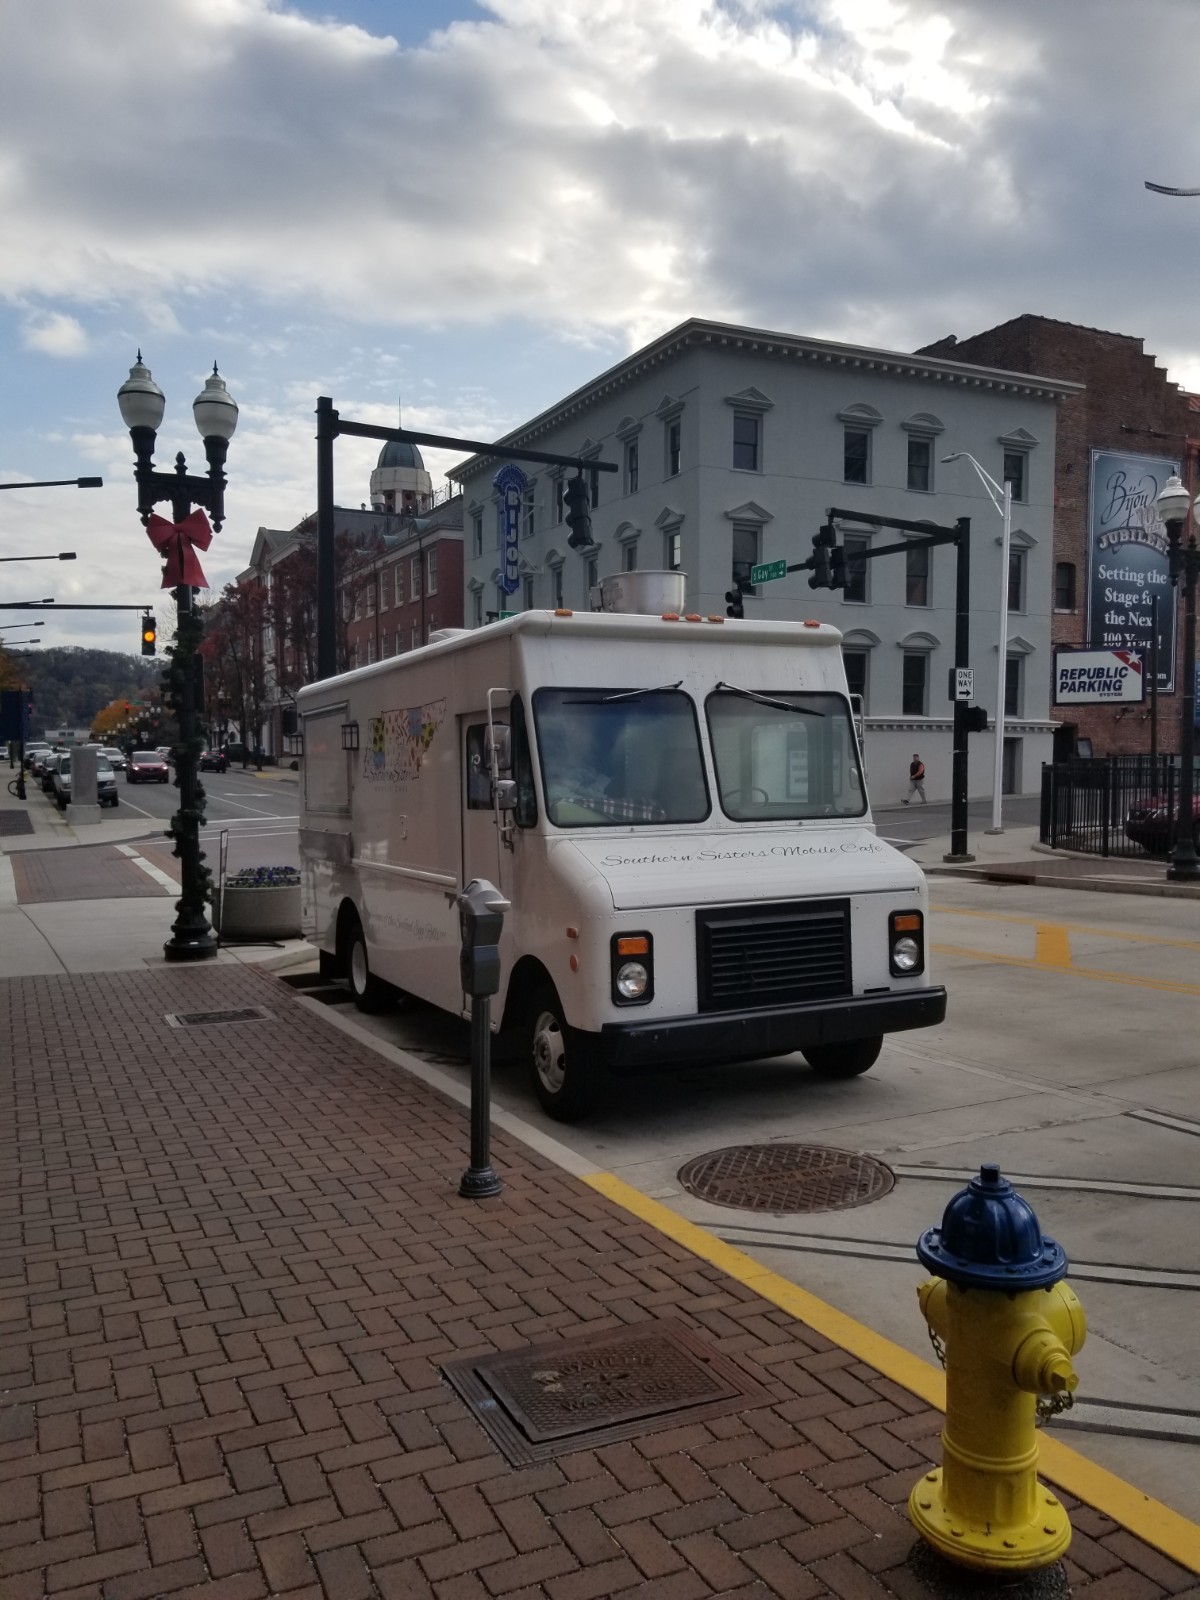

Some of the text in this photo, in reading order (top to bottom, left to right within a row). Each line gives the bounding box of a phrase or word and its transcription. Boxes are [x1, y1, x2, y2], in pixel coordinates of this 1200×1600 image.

[1101, 471, 1157, 527] Bijou
[506, 490, 519, 580] BIJOU
[1098, 565, 1167, 586] Setting the
[1105, 588, 1139, 608] Stage
[1105, 611, 1153, 627] the Nex
[958, 670, 972, 679] ONE
[1060, 666, 1129, 680] REPUBLIC
[958, 680, 972, 688] WAY
[1060, 679, 1122, 693] PARKING
[601, 843, 883, 866] Southern Sisters Mobile Cafe
